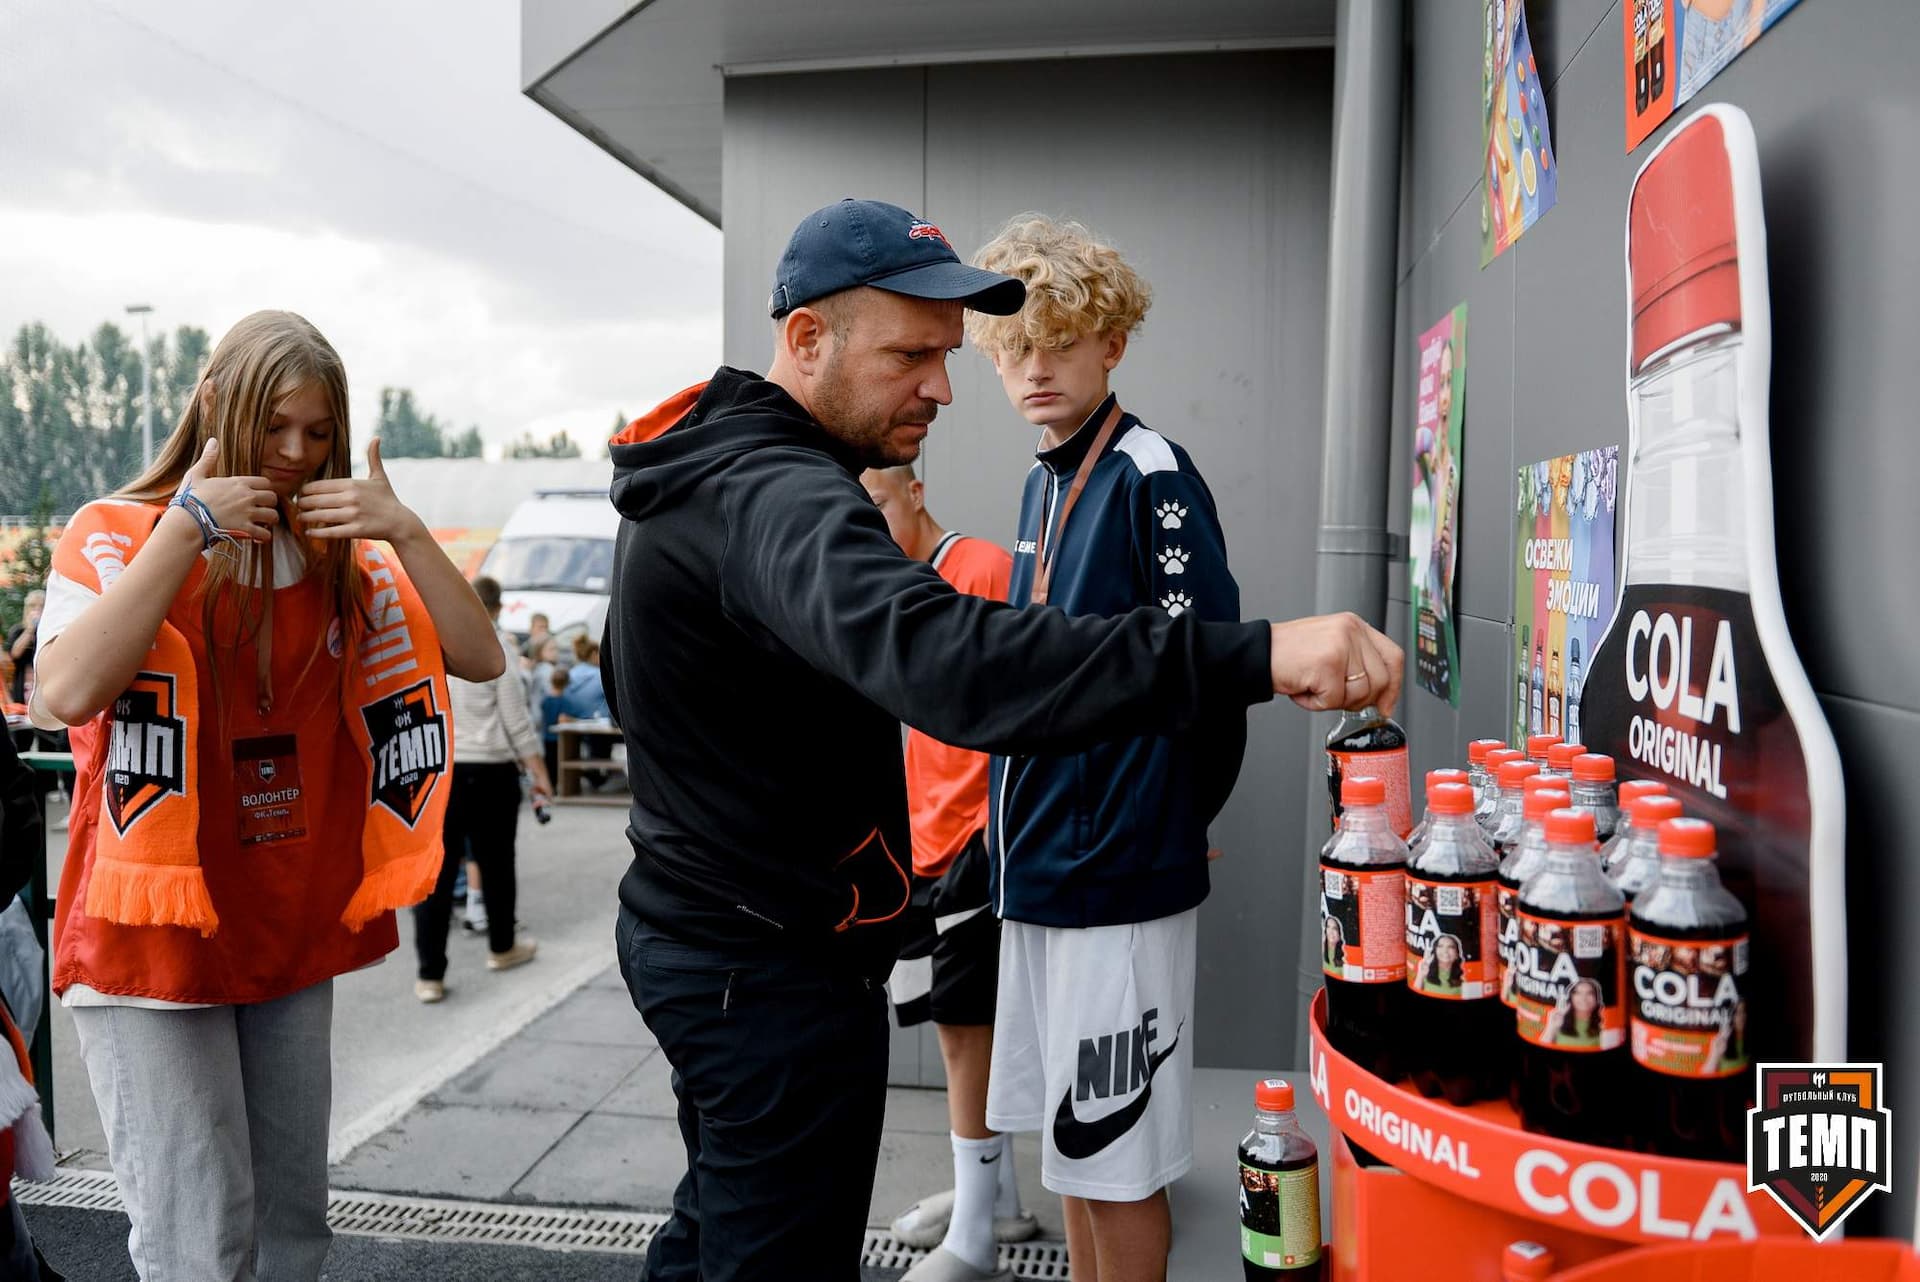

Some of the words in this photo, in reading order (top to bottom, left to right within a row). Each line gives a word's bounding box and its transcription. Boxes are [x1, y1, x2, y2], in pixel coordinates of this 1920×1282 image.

[1525, 538, 1573, 571] ОСВЕЖИ
[1546, 579, 1600, 621] ЭМОЦИИ
[1626, 610, 1741, 734] COLA
[394, 711, 412, 728] ФК
[378, 723, 442, 790] ТЕМП
[400, 772, 419, 786] 2020
[1629, 715, 1728, 800] ORIGINAL
[1634, 965, 1739, 1007] COLA
[1076, 1008, 1158, 1101] NIKE
[1344, 1087, 1480, 1179] ORIGINAL
[1514, 1149, 1759, 1241] COLA
